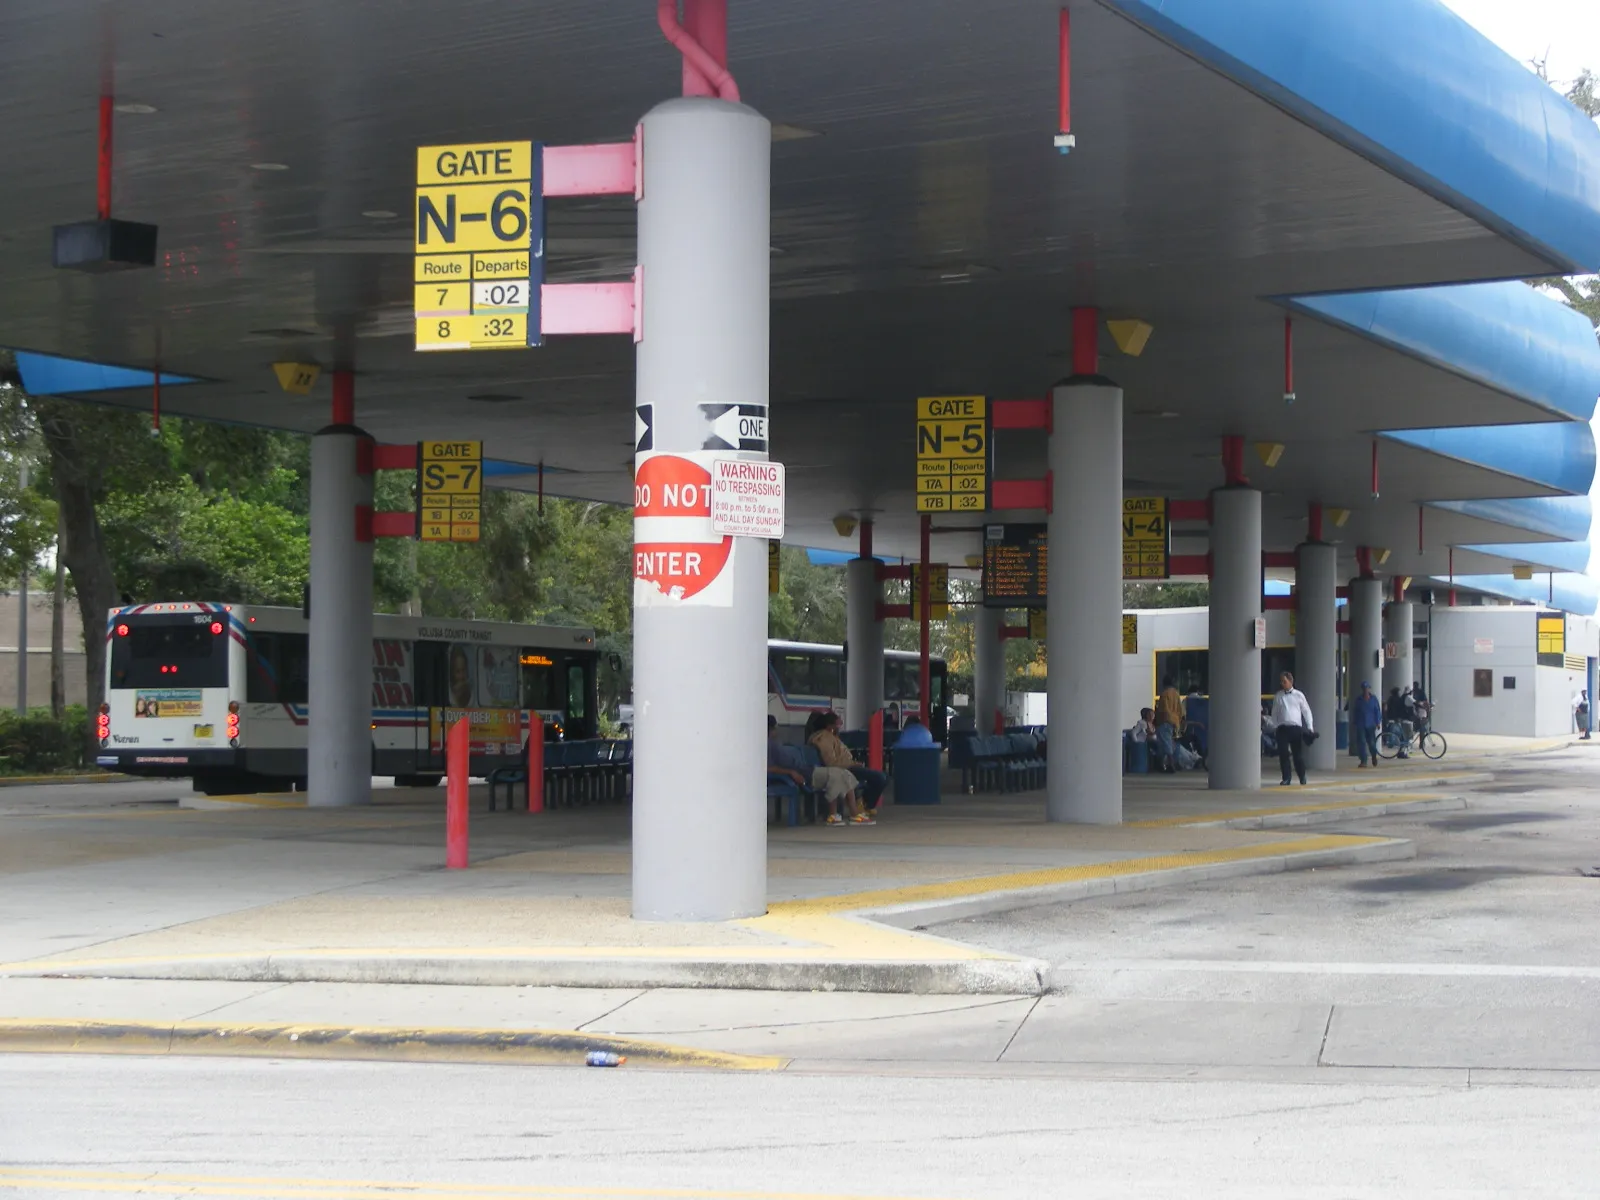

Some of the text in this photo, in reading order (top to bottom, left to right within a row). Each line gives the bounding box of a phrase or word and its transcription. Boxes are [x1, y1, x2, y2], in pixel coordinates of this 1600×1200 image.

[436, 148, 513, 178] GATE
[417, 190, 528, 245] N-6
[423, 259, 528, 275] Route Departs
[436, 284, 520, 306] 7 :02
[438, 318, 514, 339] 8 :32
[928, 399, 975, 416] GATE
[739, 417, 764, 438] ONE
[918, 423, 984, 454] N-5
[432, 443, 471, 457] GATE
[720, 462, 777, 482] WARNING
[922, 462, 984, 473] Route Departs
[425, 464, 477, 491] S-7
[925, 478, 978, 490] 17A :02
[635, 484, 711, 508] DO NOT
[715, 479, 781, 497] NO TRESPASSING
[715, 501, 729, 511] 8:00
[744, 504, 752, 513] to
[752, 505, 766, 513] 5:00
[925, 496, 978, 508] 17B :32
[1124, 499, 1157, 511] GATE
[714, 513, 781, 527] AND ALL DAY SUNDAY
[1123, 516, 1164, 538] N-4
[636, 551, 702, 576] ENTER
[193, 615, 213, 624] 1604
[418, 627, 493, 642] VOLUSIA COUNTY TRANSIT
